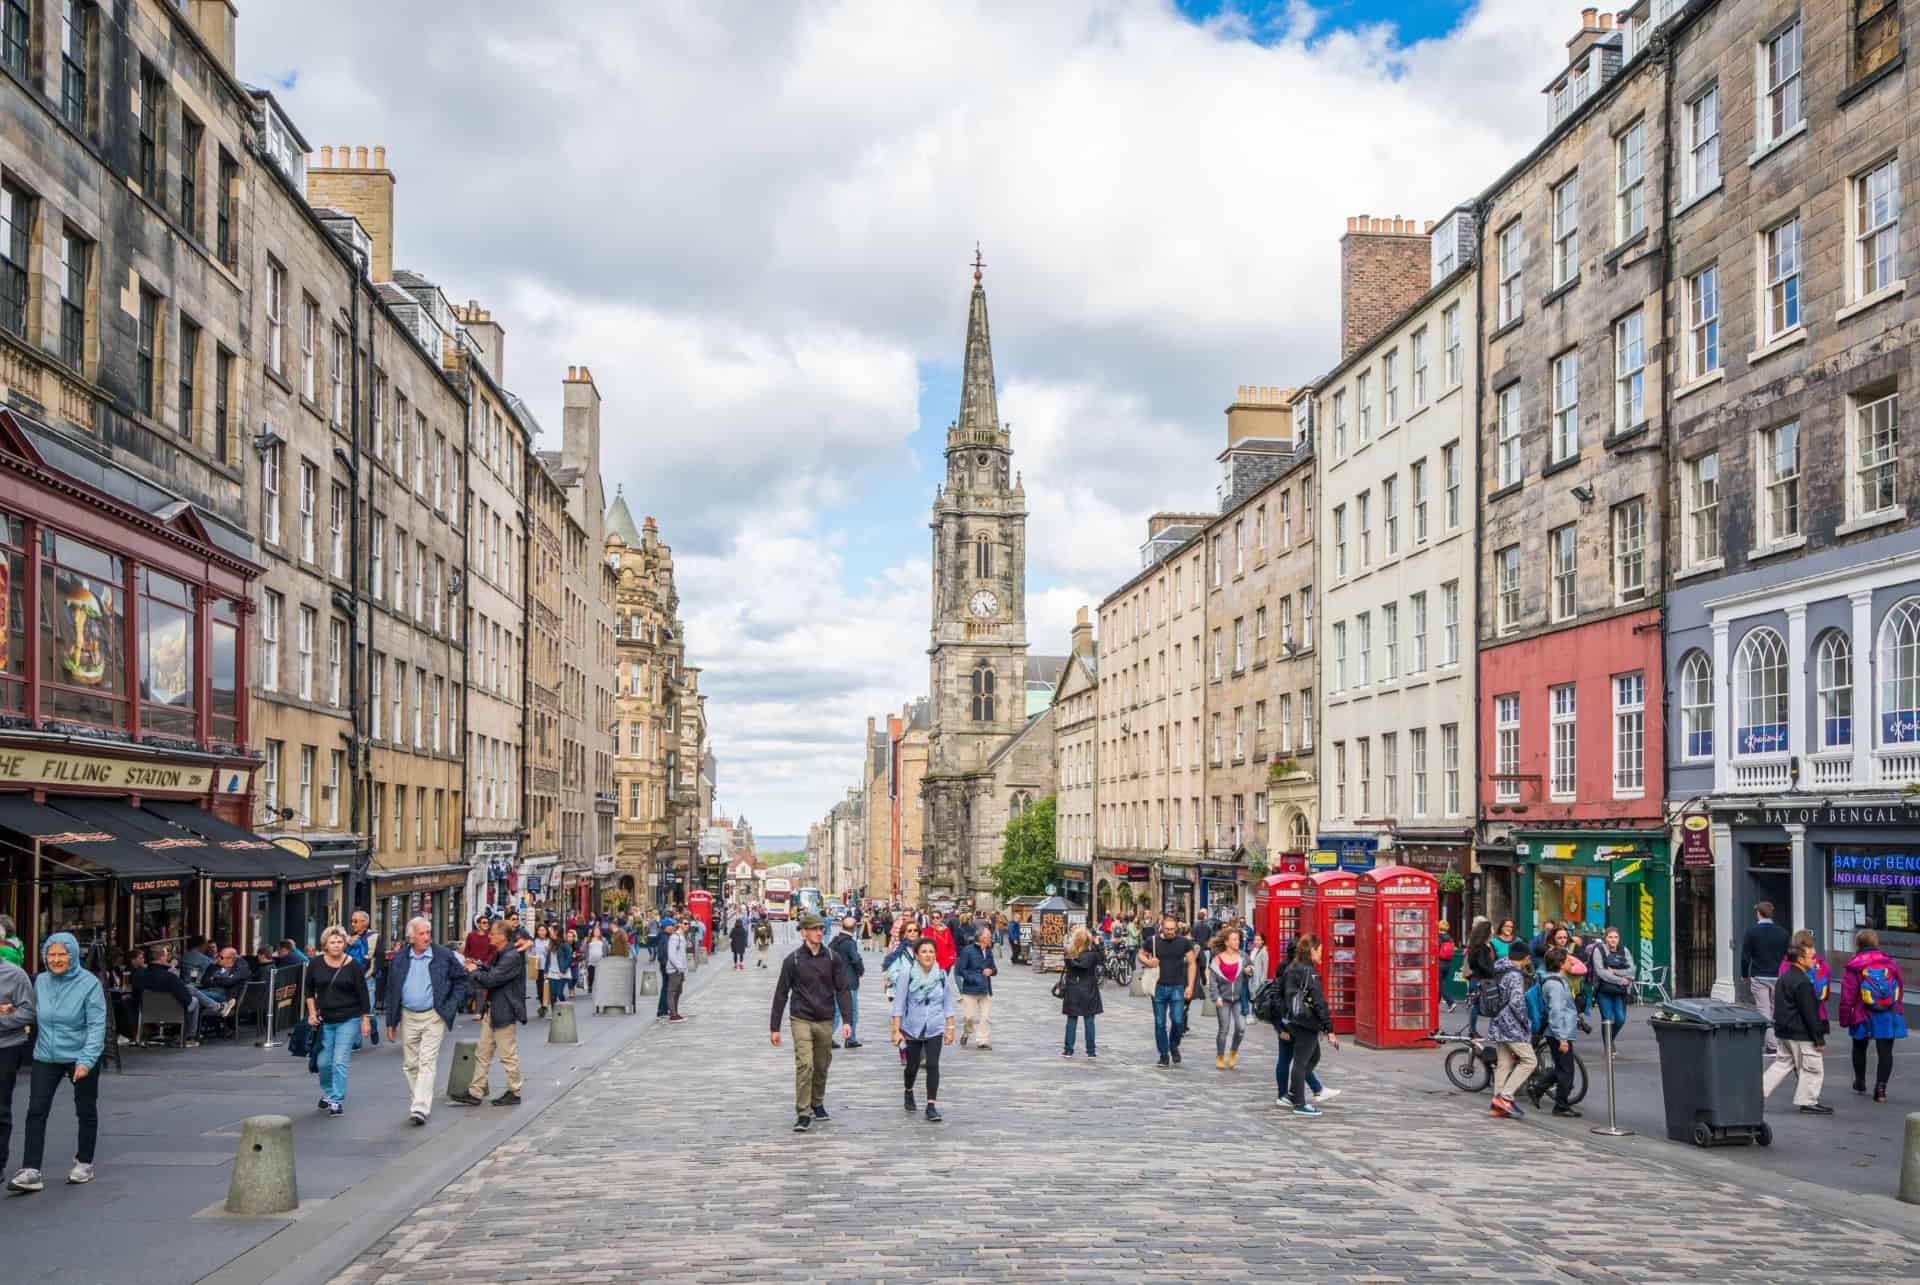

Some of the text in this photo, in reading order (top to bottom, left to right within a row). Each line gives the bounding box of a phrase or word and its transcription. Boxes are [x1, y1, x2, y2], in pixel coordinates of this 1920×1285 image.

[41, 759, 112, 782] FILLING
[124, 766, 181, 787] STATION
[1765, 808, 1791, 824] BAY
[1800, 808, 1819, 823] OF
[1829, 807, 1897, 823] BENGAL
[1834, 855, 1858, 869] BAY
[1863, 856, 1881, 871] OF
[1834, 872, 1871, 884] INDIAN
[1640, 882, 1654, 990] SUBWAY
